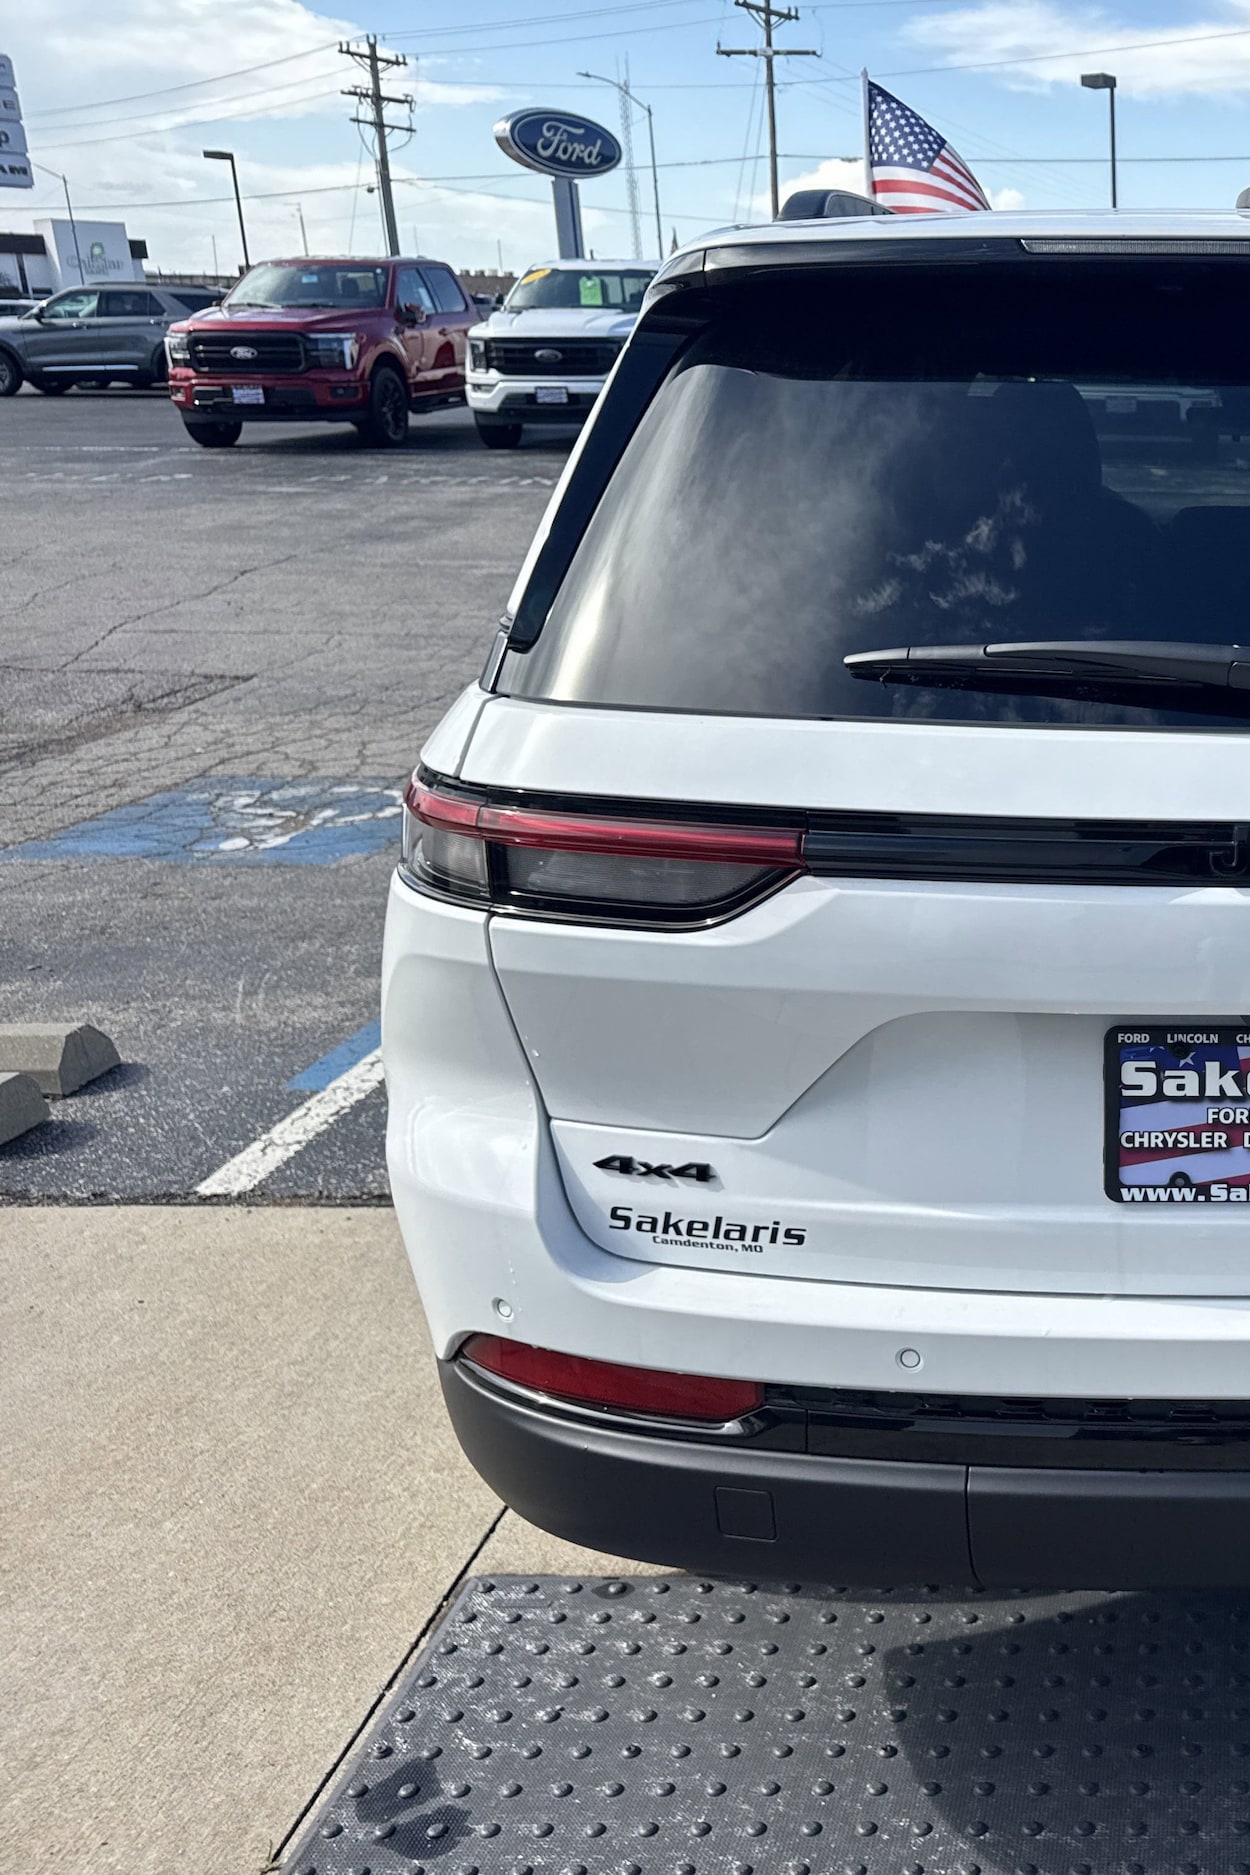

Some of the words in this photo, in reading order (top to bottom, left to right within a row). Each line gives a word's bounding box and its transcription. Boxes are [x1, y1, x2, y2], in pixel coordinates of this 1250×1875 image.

[537, 121, 602, 165] Ford
[1117, 1033, 1150, 1044] FORD
[1166, 1033, 1219, 1044] LINCOLN
[1120, 1131, 1228, 1149] CHRYSLER
[592, 1154, 717, 1183] 4x4
[608, 1206, 807, 1246] Sakelaris
[652, 1235, 739, 1252] Camdenton,
[741, 1244, 764, 1253] MO
